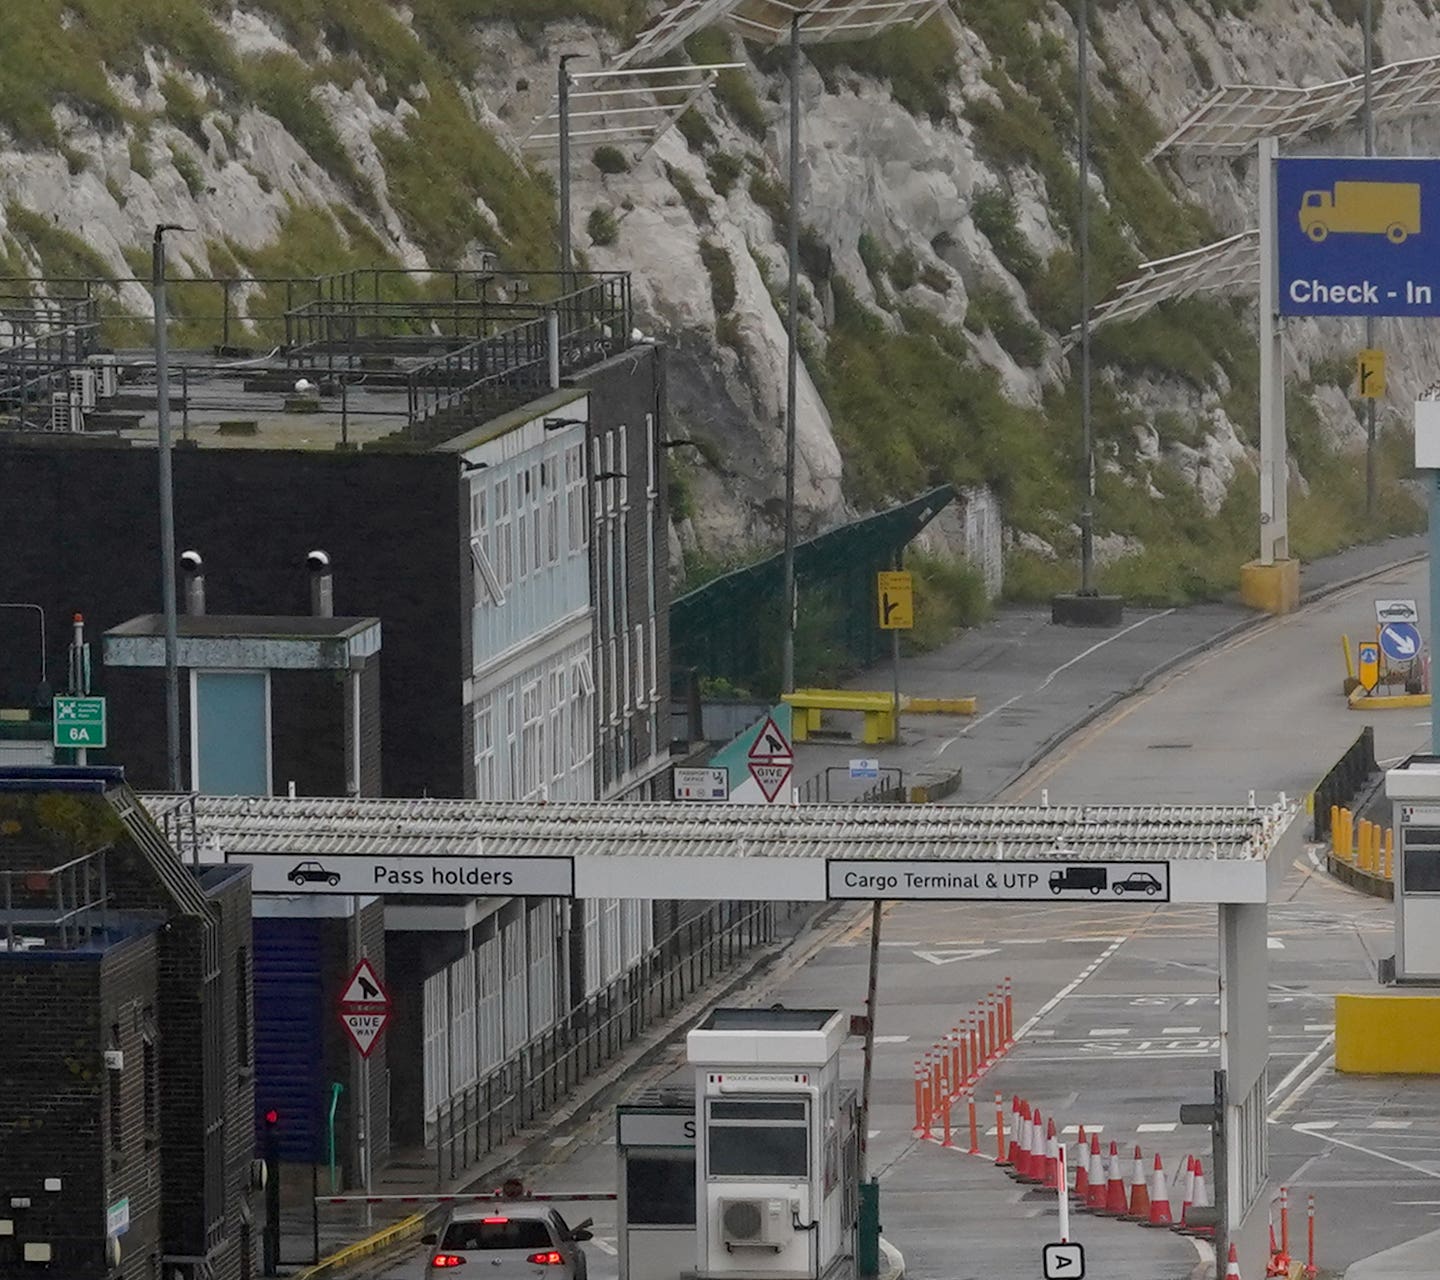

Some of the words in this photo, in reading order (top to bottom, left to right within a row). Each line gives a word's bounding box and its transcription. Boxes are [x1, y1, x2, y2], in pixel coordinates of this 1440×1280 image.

[1289, 278, 1377, 306] Check
[1404, 280, 1432, 305] In
[69, 729, 90, 741] 6A
[757, 768, 783, 778] GIVE
[374, 865, 423, 885] Pass
[431, 864, 513, 885] holders
[844, 869, 898, 893] Cargo
[903, 872, 978, 889] Terminal
[984, 873, 997, 888] &
[1003, 872, 1039, 888] UTP
[349, 1017, 379, 1027] GIVE
[1056, 1255, 1072, 1269] A
